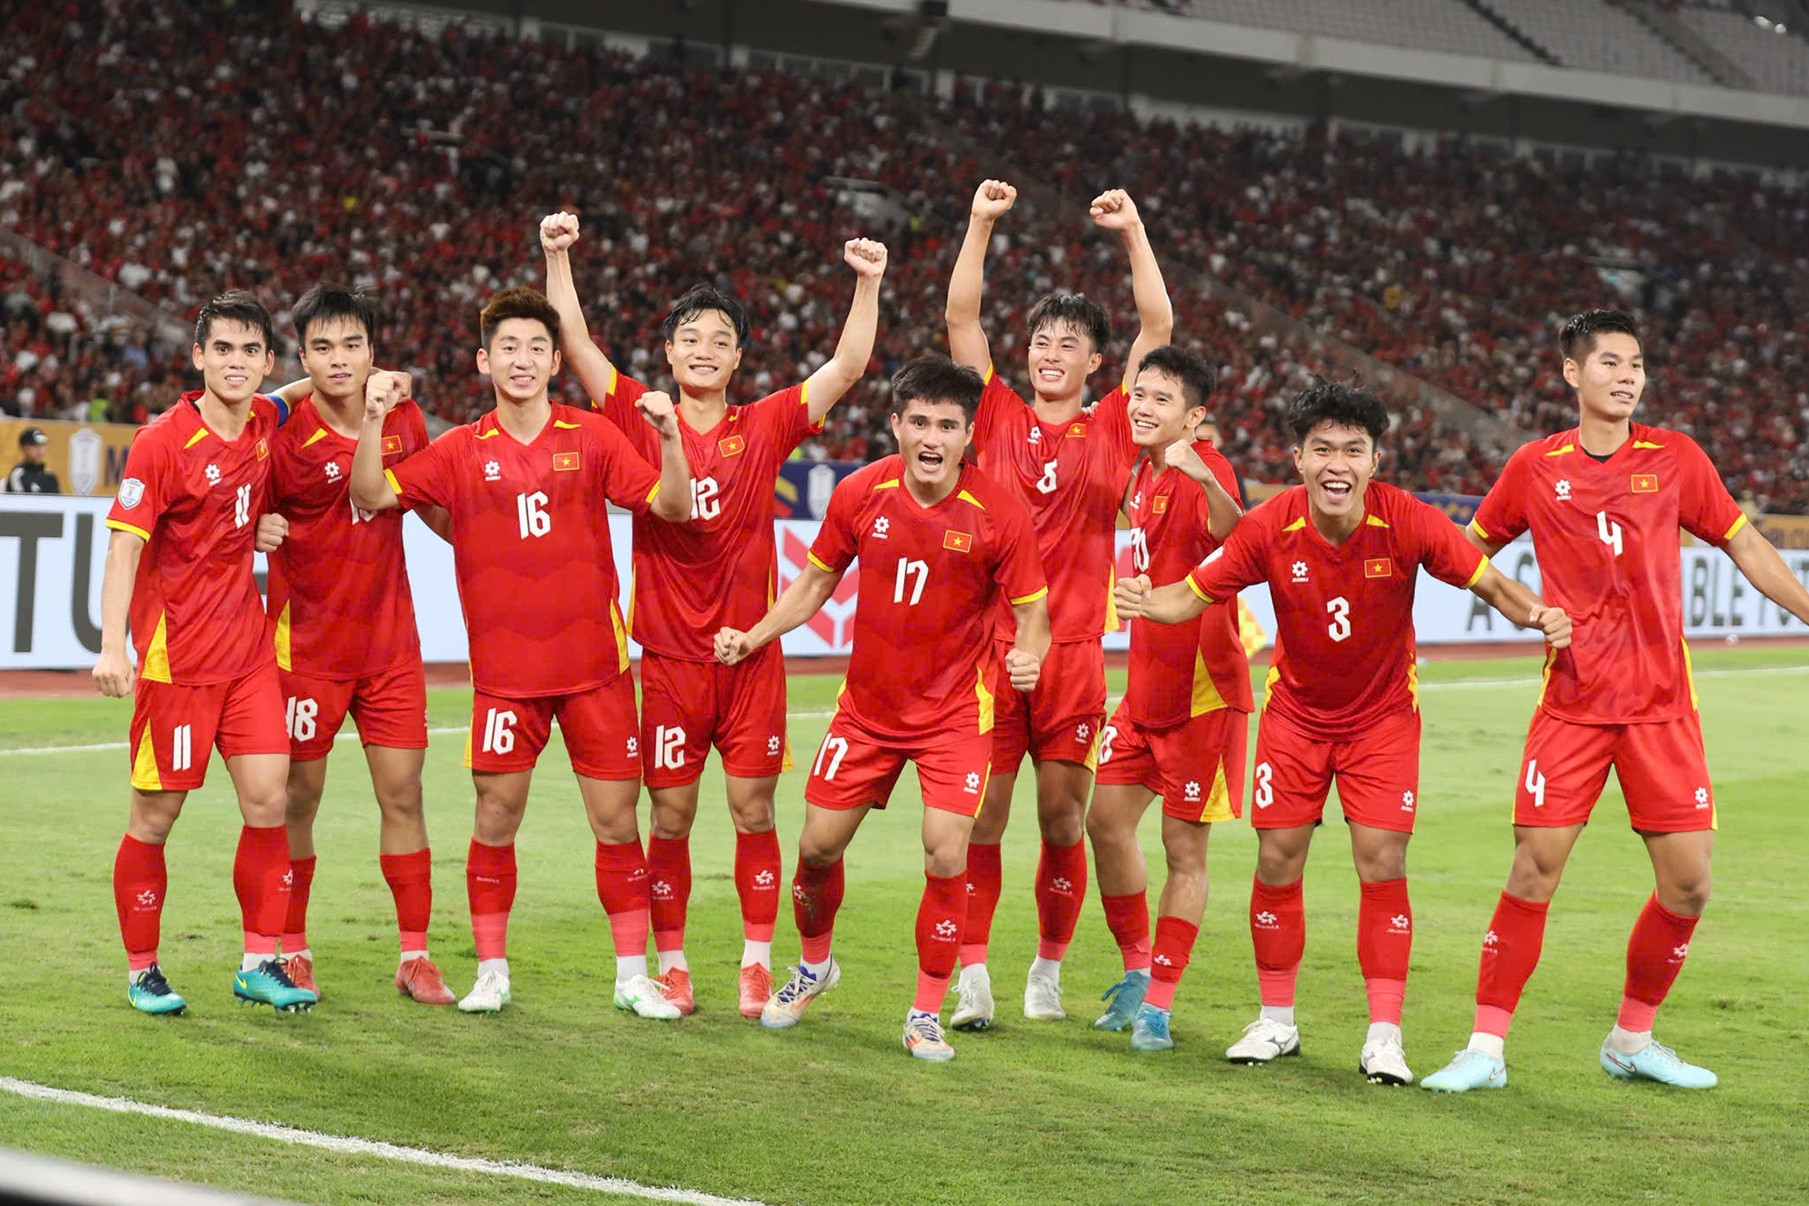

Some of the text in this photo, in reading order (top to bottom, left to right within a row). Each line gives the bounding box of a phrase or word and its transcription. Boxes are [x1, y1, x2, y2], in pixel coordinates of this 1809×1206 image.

[235, 483, 251, 529] 11
[517, 490, 551, 540] 16
[690, 476, 721, 521] 12
[1596, 510, 1623, 556] 4
[893, 557, 929, 606] 17
[1326, 596, 1352, 643] 3
[173, 714, 191, 771] 11
[286, 696, 318, 742] 18
[482, 707, 517, 755] 16
[655, 725, 686, 770] 12
[813, 732, 849, 781] 17
[1255, 761, 1274, 809] 3
[1525, 759, 1546, 808] 4
